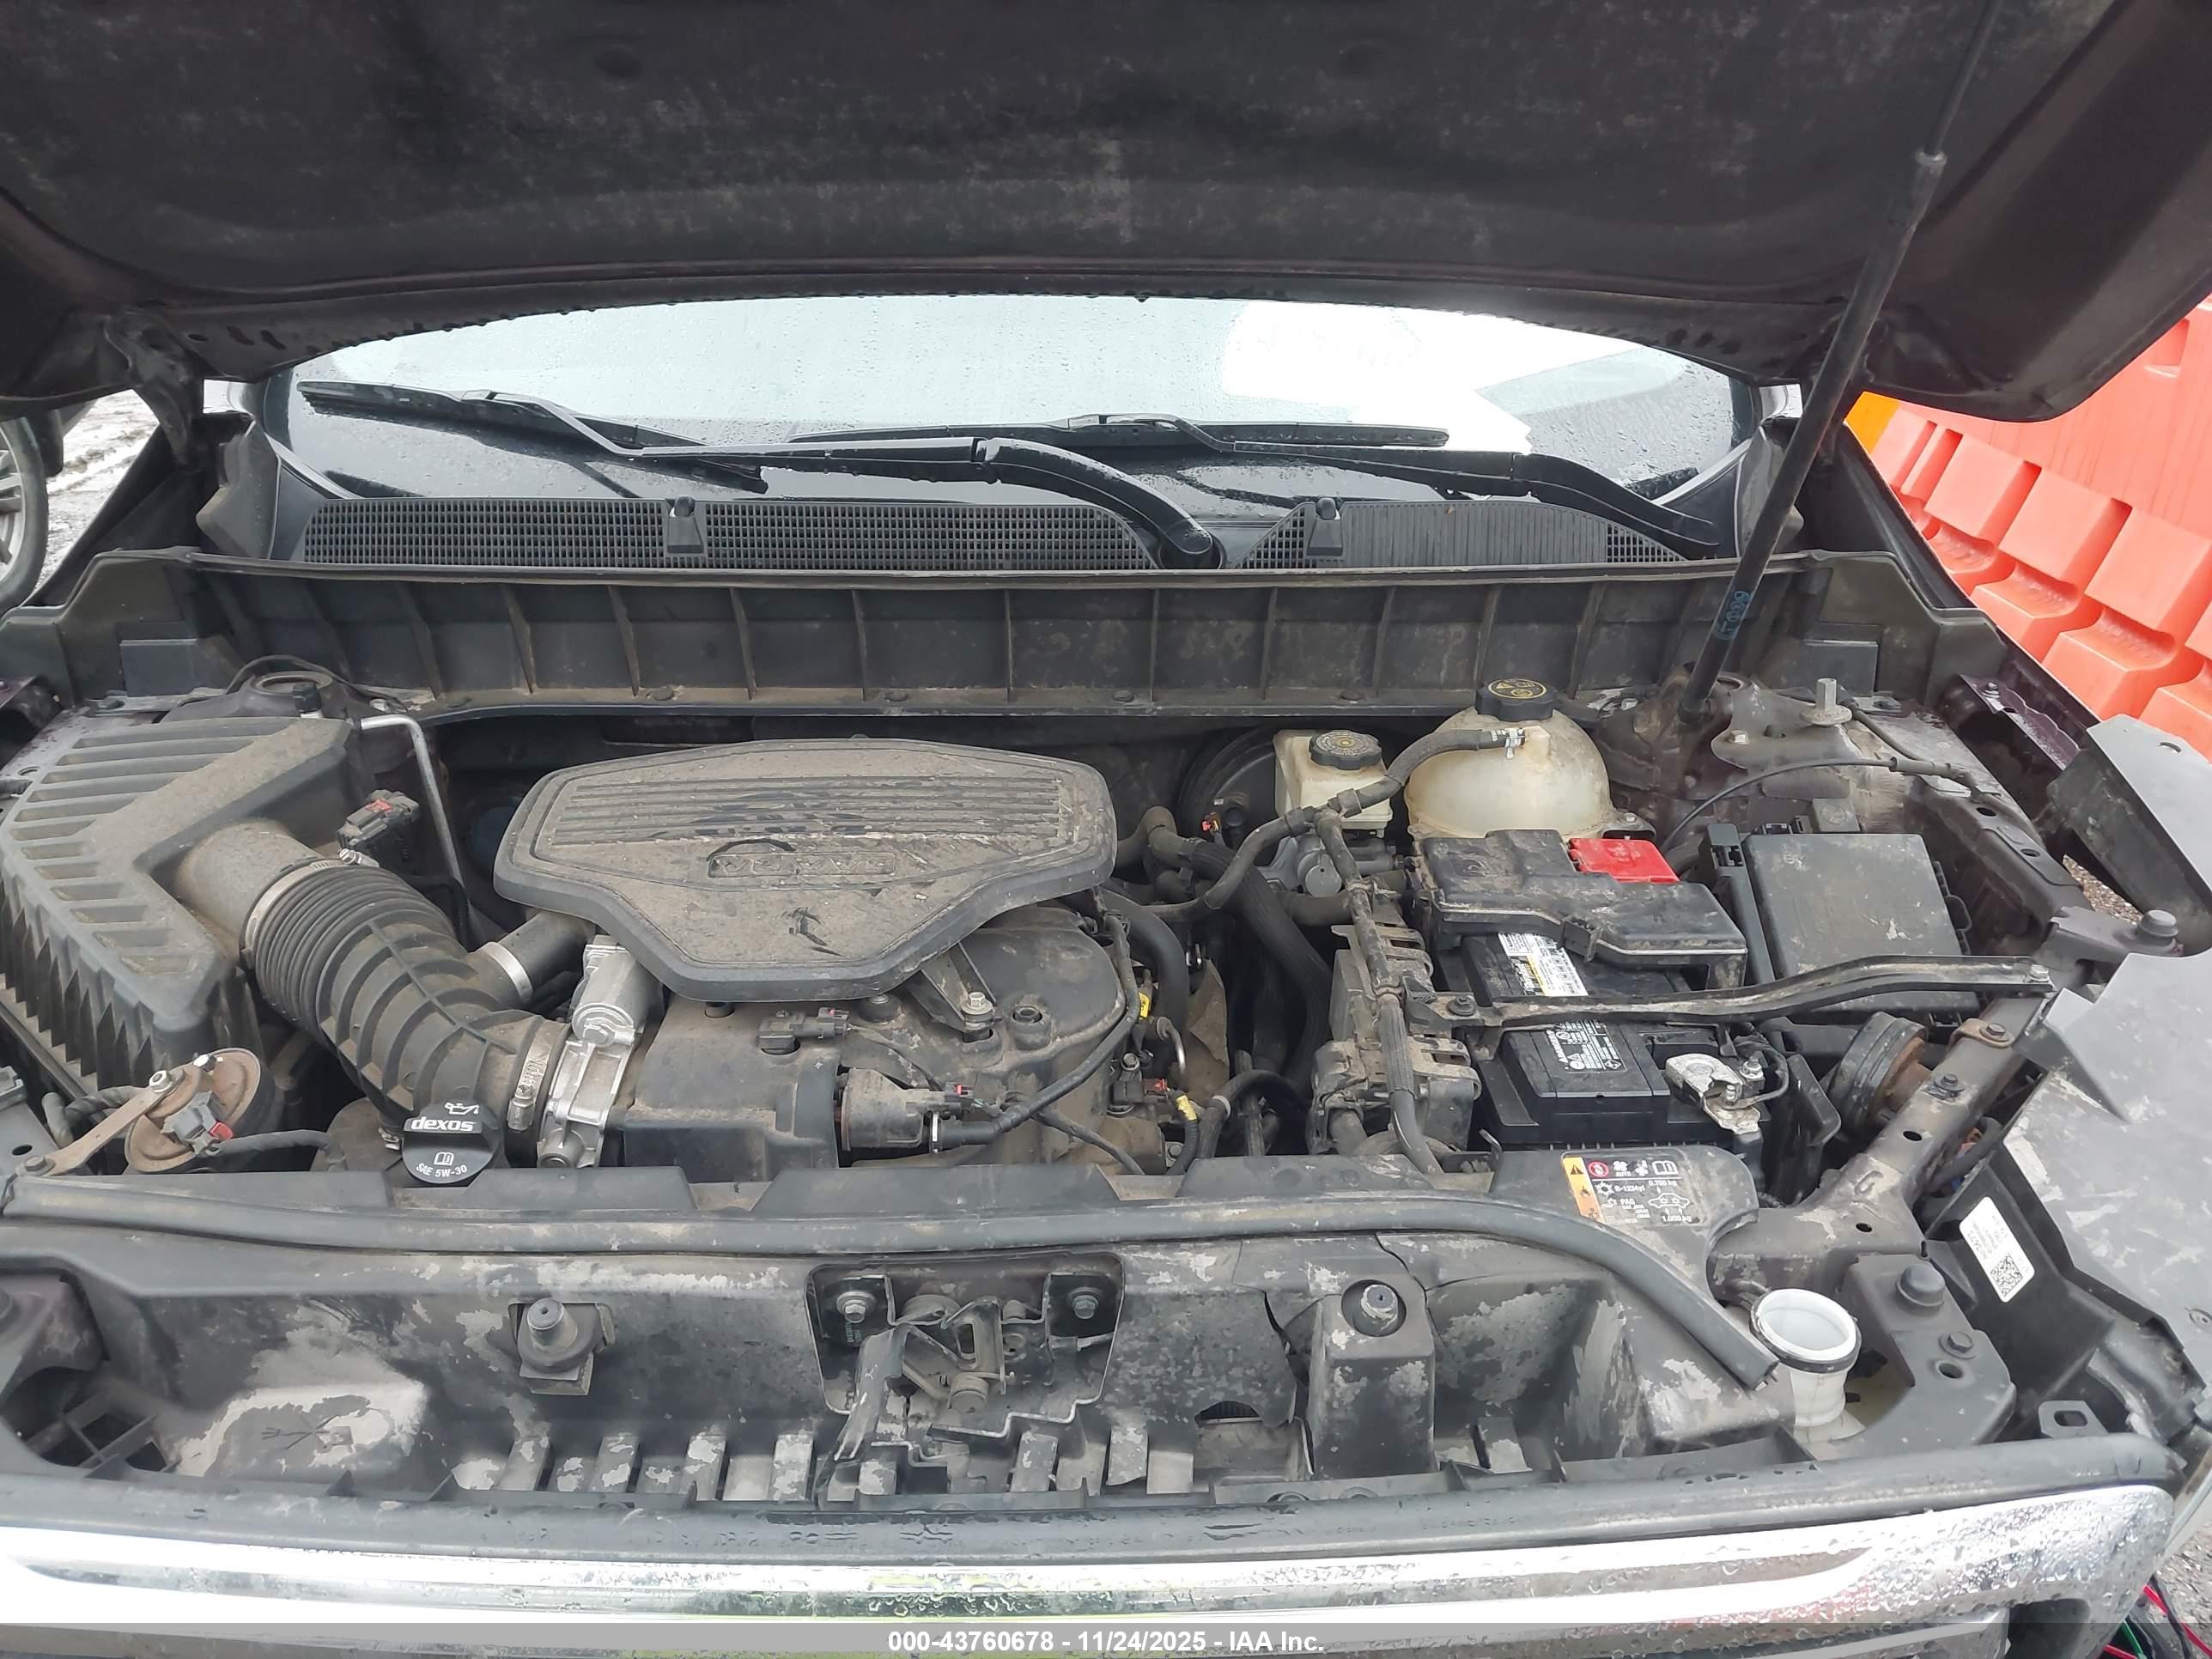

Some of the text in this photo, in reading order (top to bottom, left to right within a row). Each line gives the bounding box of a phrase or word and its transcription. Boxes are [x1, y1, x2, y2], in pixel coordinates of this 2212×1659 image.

[411, 1117, 476, 1132] dexos
[416, 1163, 468, 1177] SAE 5W-30
